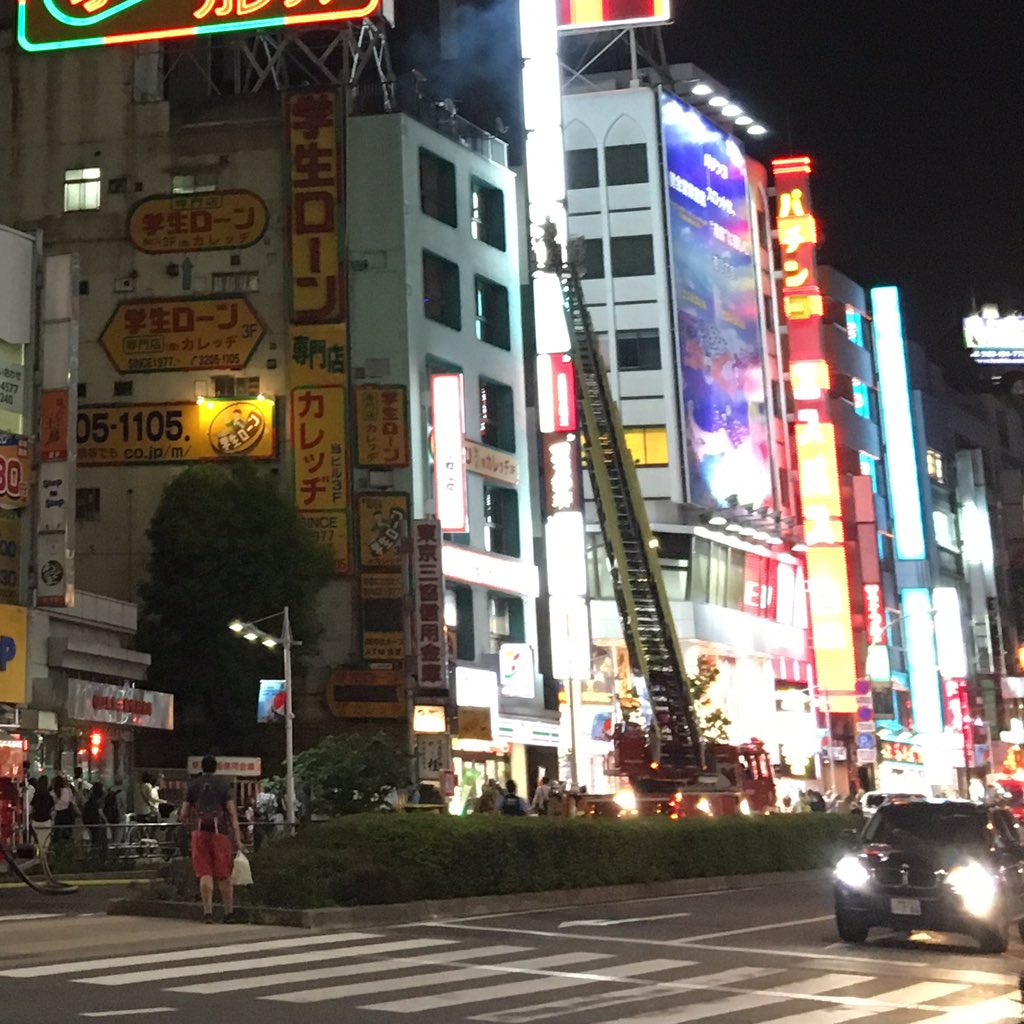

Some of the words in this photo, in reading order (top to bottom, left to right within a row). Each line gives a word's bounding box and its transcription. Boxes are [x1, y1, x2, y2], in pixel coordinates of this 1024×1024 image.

[143, 206, 256, 236] 学生ローン
[291, 94, 336, 324] 学生ローン
[124, 303, 239, 334] 学生ローン
[292, 335, 346, 374] 専門店
[416, 523, 442, 682] 東京三協信用金庫
